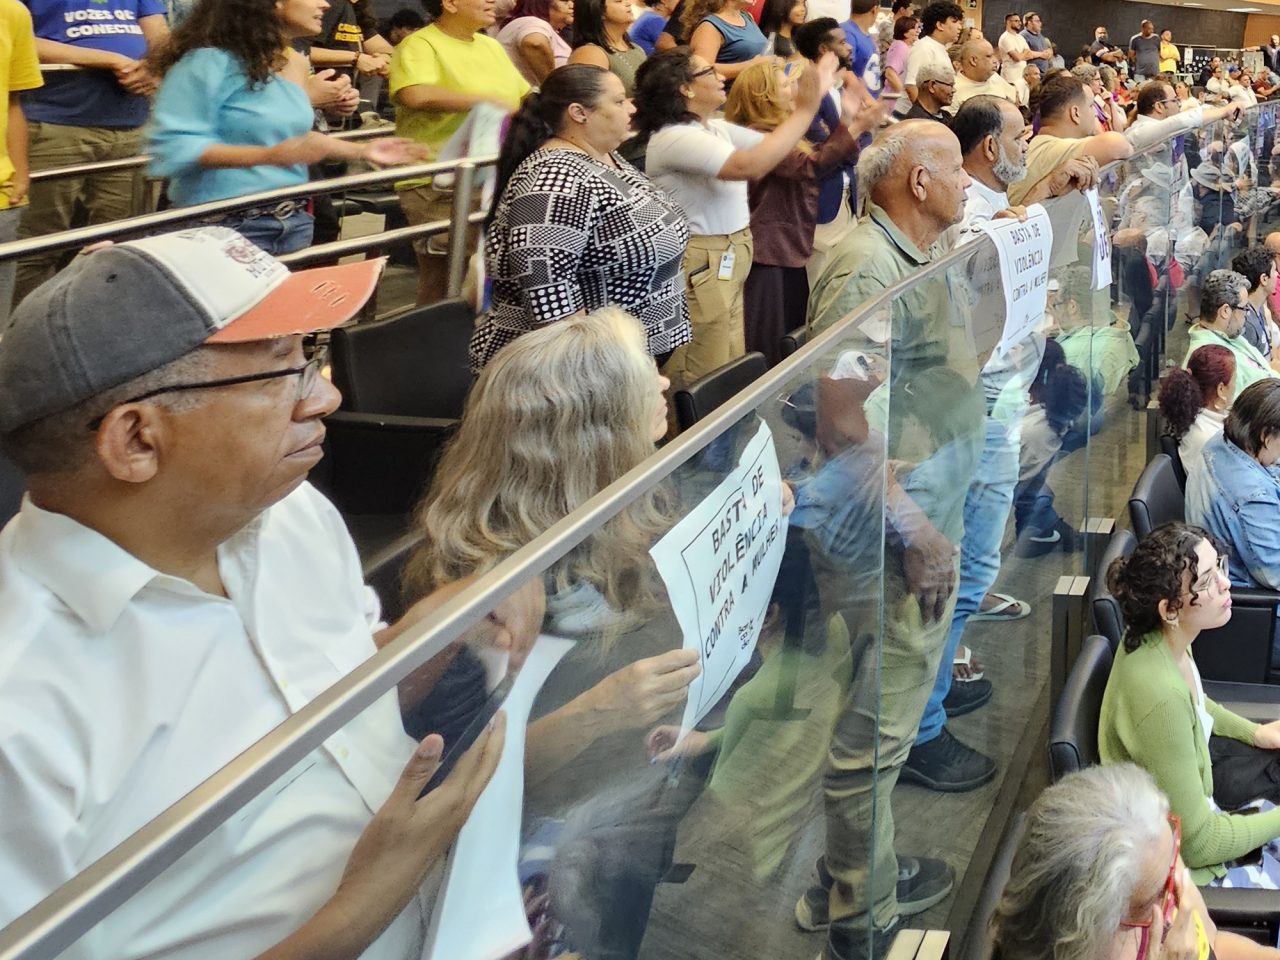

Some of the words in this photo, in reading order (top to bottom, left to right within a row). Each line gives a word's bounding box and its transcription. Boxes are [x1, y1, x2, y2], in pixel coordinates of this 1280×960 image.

[64, 9, 114, 23] VOZES
[1010, 226, 1032, 245] BASTA
[752, 464, 764, 497] DE
[709, 502, 768, 605] VIOLÊNCIA
[705, 590, 735, 658] CONTRA
[741, 573, 748, 594] A
